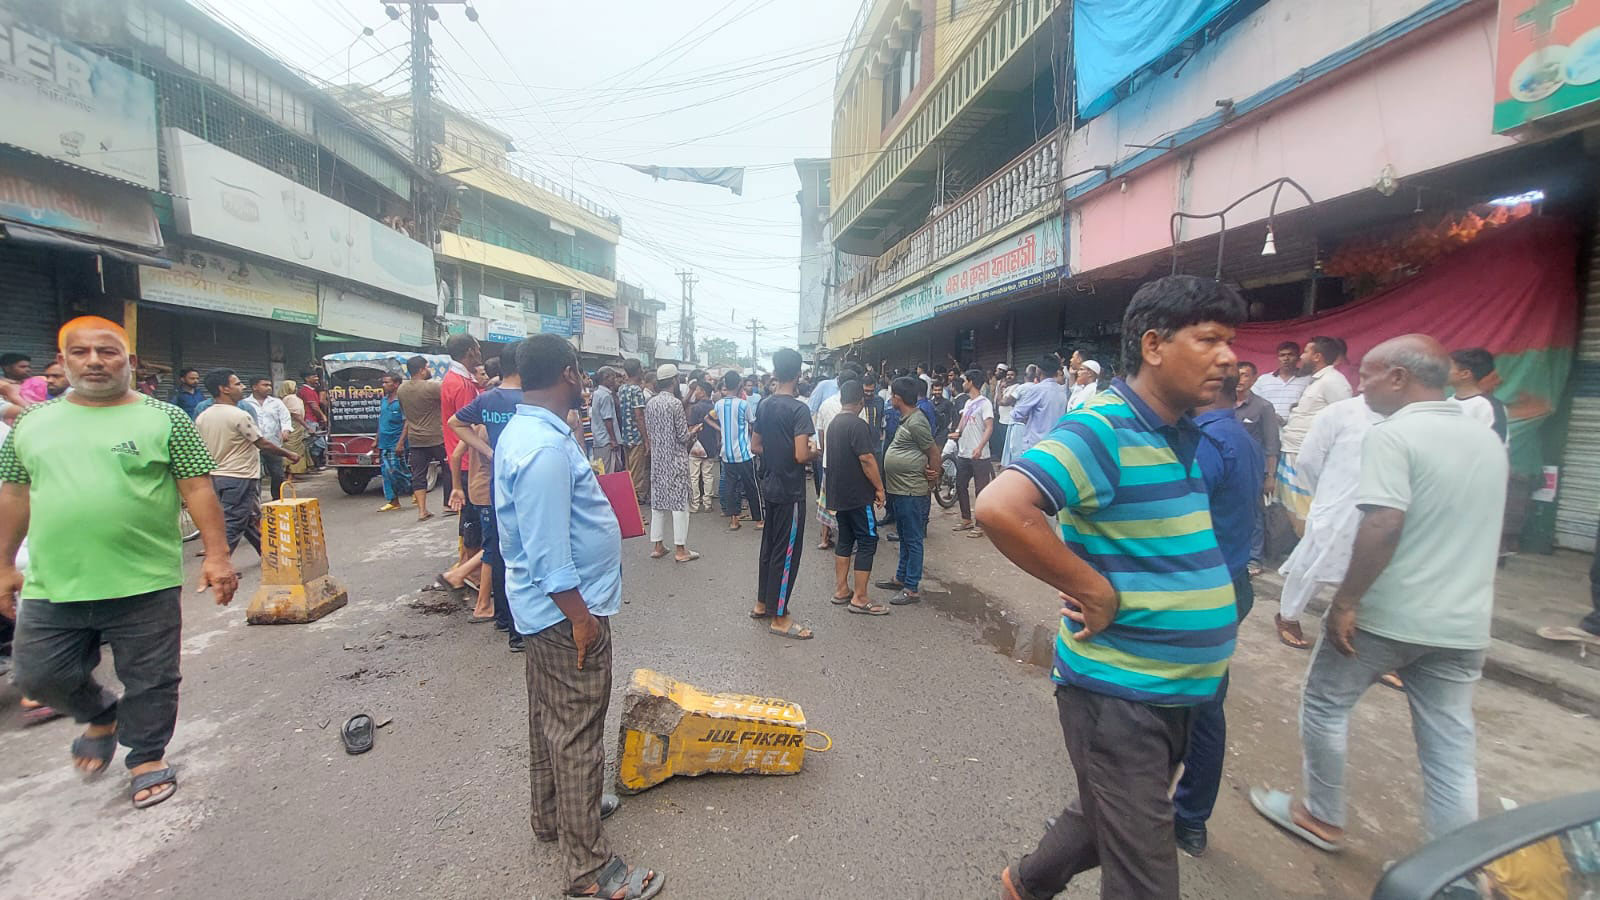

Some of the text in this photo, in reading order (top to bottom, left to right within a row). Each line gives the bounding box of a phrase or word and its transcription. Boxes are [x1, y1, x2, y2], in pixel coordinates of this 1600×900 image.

[266, 505, 279, 573] JULFIKAR
[279, 511, 292, 568] STEEL
[711, 701, 796, 718] STEEL
[698, 729, 803, 748] JULFIKAR
[705, 747, 791, 767] STEEL
